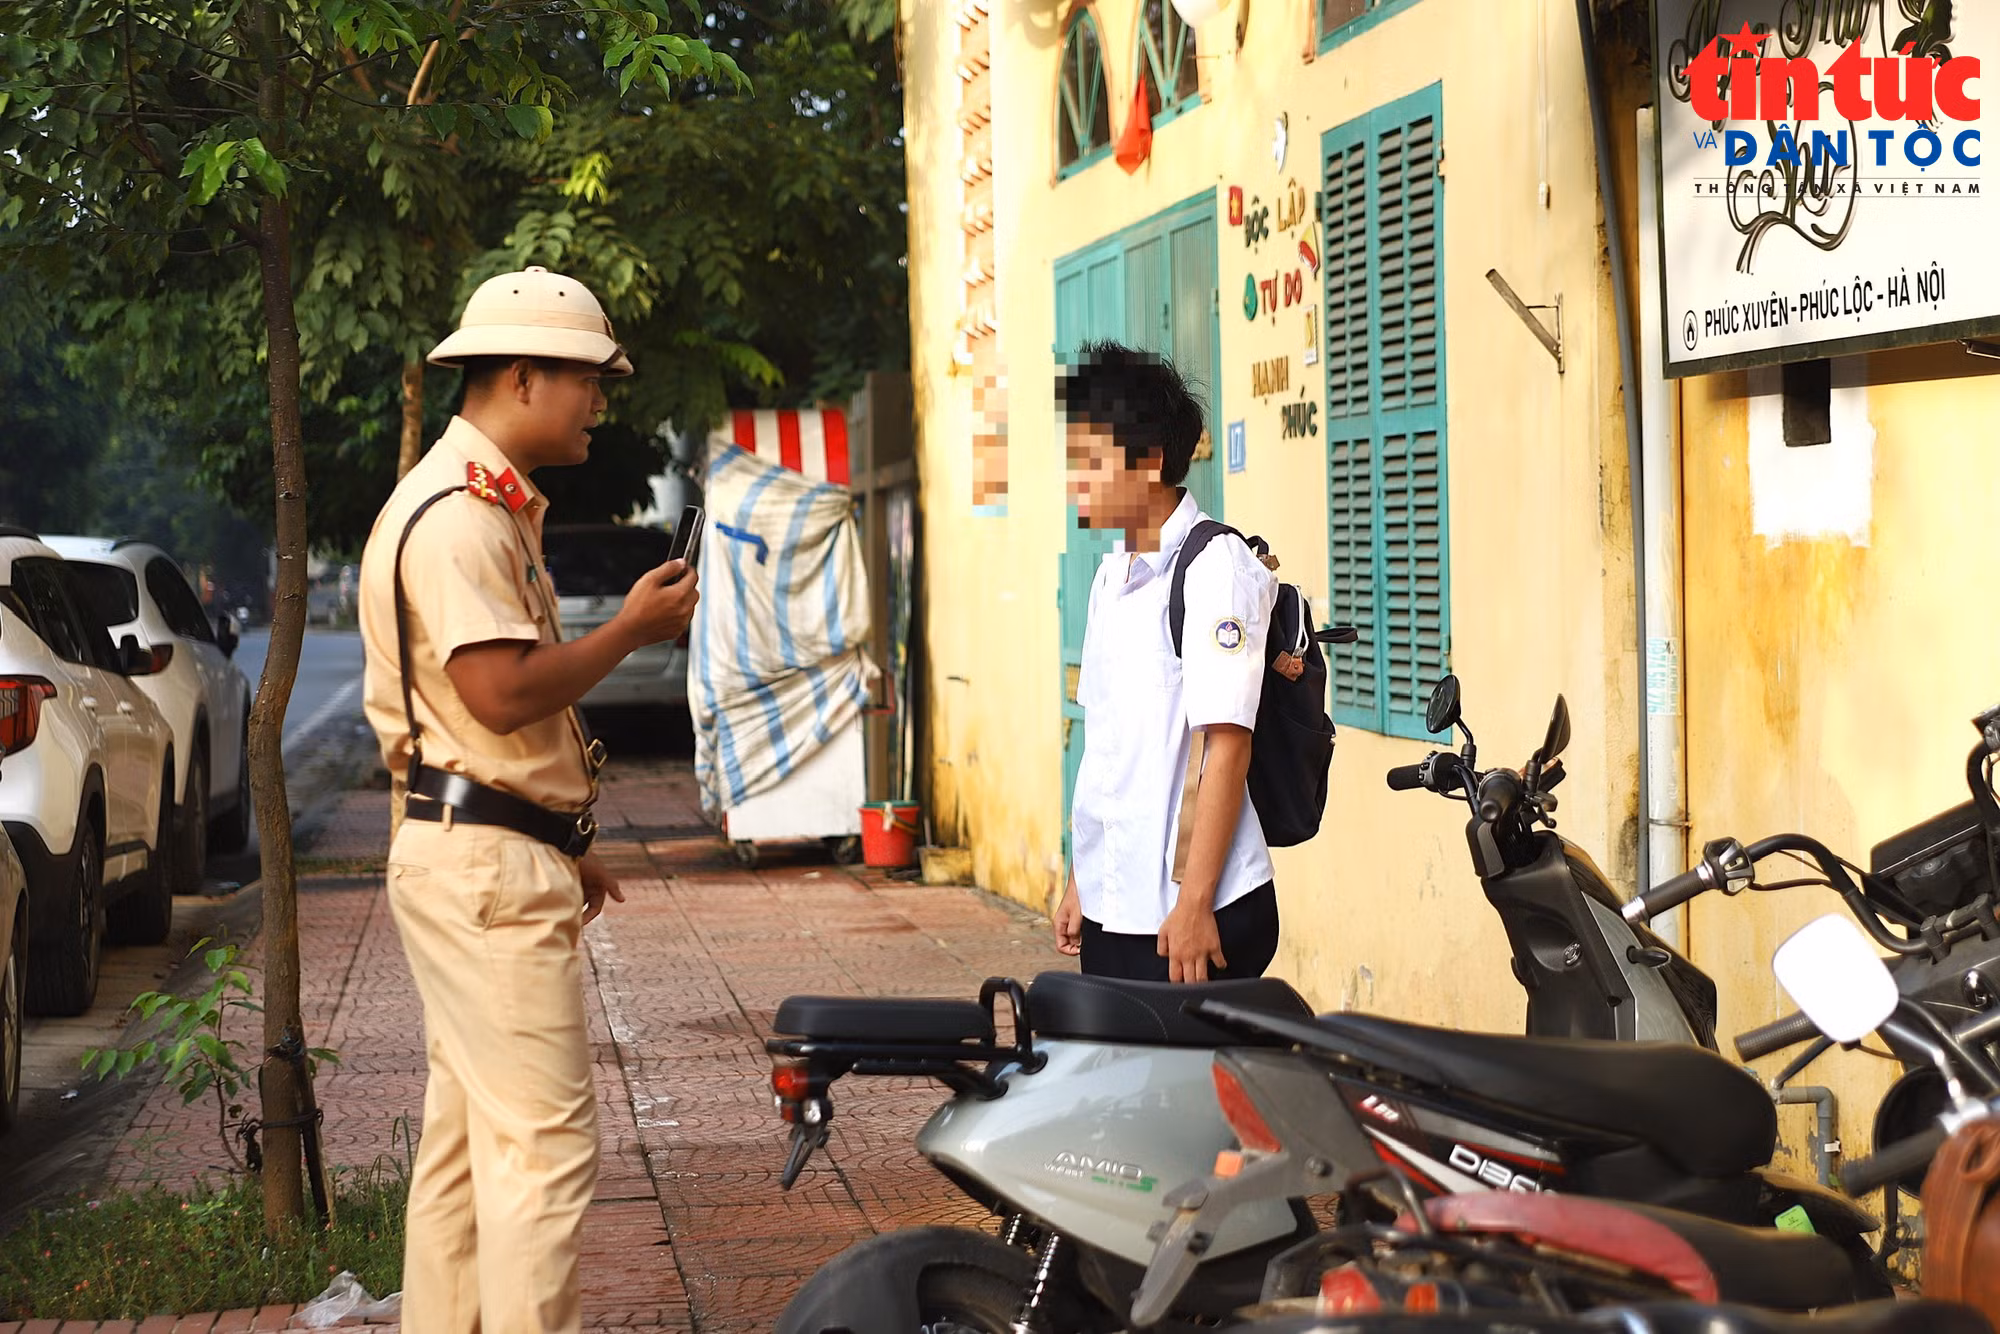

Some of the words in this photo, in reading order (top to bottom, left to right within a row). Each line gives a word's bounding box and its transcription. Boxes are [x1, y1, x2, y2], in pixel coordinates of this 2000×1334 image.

[1284, 268, 1302, 308] DO
[1705, 300, 1739, 338] PHÚC
[1800, 280, 1839, 322] PHÚC
[1843, 276, 1873, 322] LỘC
[1888, 267, 1910, 308] HÀ
[1917, 261, 1946, 310] NỘI
[1449, 1144, 1541, 1193] DIBA
